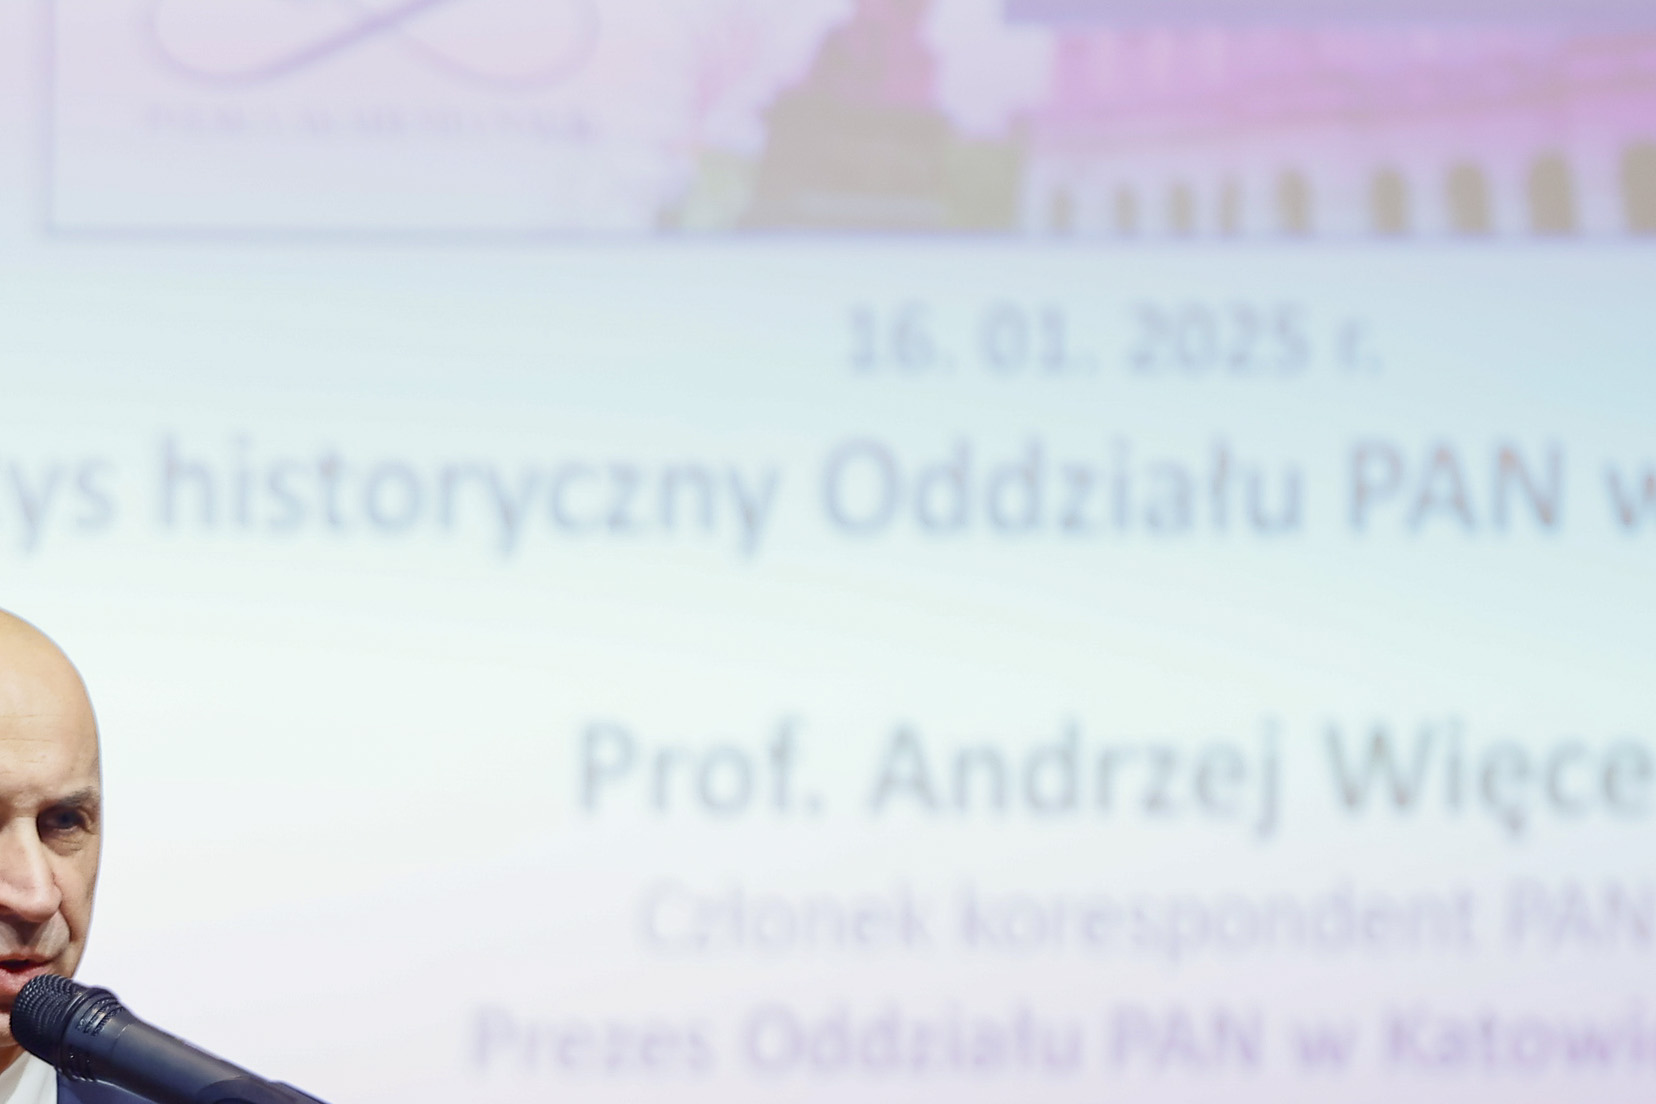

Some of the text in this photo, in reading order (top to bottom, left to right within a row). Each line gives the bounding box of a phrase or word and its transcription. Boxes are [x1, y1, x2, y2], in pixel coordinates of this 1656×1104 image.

[846, 302, 1381, 378] 16. 01. 2025 r.
[156, 434, 778, 555] historyczny
[820, 435, 1304, 538] Oddziału
[1347, 438, 1562, 536] PAN
[576, 714, 823, 816] Prof.
[868, 714, 1282, 842] Andrzej
[638, 878, 932, 955] Członek
[959, 878, 1474, 967] korespondent
[468, 1003, 716, 1077] Prezes
[742, 1000, 1084, 1077] Oddziału
[1108, 1003, 1260, 1075] PAN
[1292, 1020, 1358, 1073] w
